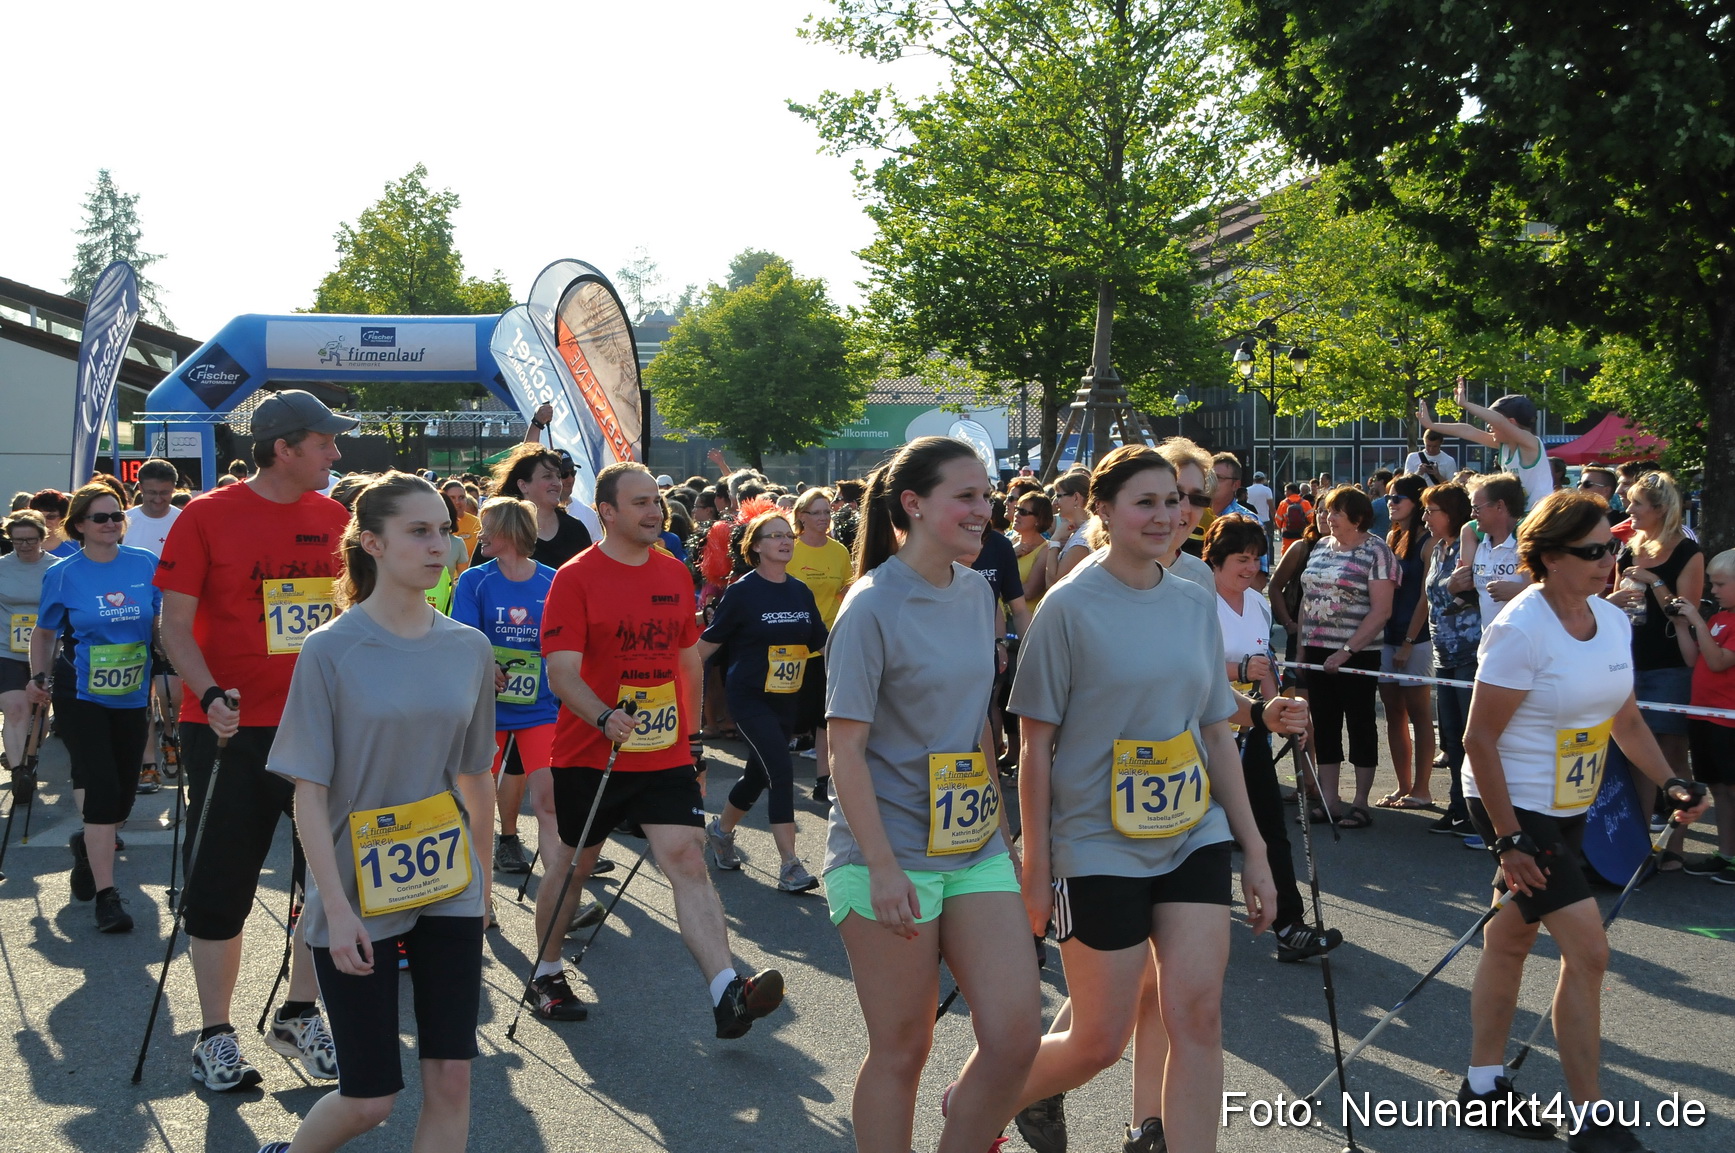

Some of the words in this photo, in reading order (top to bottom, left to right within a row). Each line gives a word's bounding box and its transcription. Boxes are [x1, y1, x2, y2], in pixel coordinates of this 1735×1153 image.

[367, 332, 394, 341] Fischer
[91, 290, 129, 411] Fischer
[348, 347, 426, 362] firmenlauf
[196, 366, 240, 380] Fischer
[295, 534, 321, 543] swn
[95, 595, 107, 610] I
[651, 594, 674, 603] swn
[99, 605, 141, 617] camping
[495, 606, 505, 624] I
[269, 603, 333, 635] 1352
[495, 625, 539, 637] camping
[92, 665, 144, 689] 5057
[621, 669, 651, 680] Alles
[773, 661, 801, 681] 491
[1128, 756, 1168, 766] firmenlauf
[948, 768, 985, 779] firmenlauf
[1118, 768, 1150, 776] walken
[937, 782, 968, 791] walken
[1116, 765, 1202, 814] 1371
[1147, 813, 1171, 821] Isabella
[370, 821, 413, 837] firmenlauf
[1138, 822, 1175, 830] Steuerkanzlei
[951, 828, 971, 837] Kathrin
[359, 837, 395, 849] walken
[360, 827, 462, 889] 1367
[396, 881, 422, 893] Corinna
[422, 876, 441, 888] Martin
[388, 890, 427, 904] Steuerkanzlei
[433, 882, 449, 893] Müller
